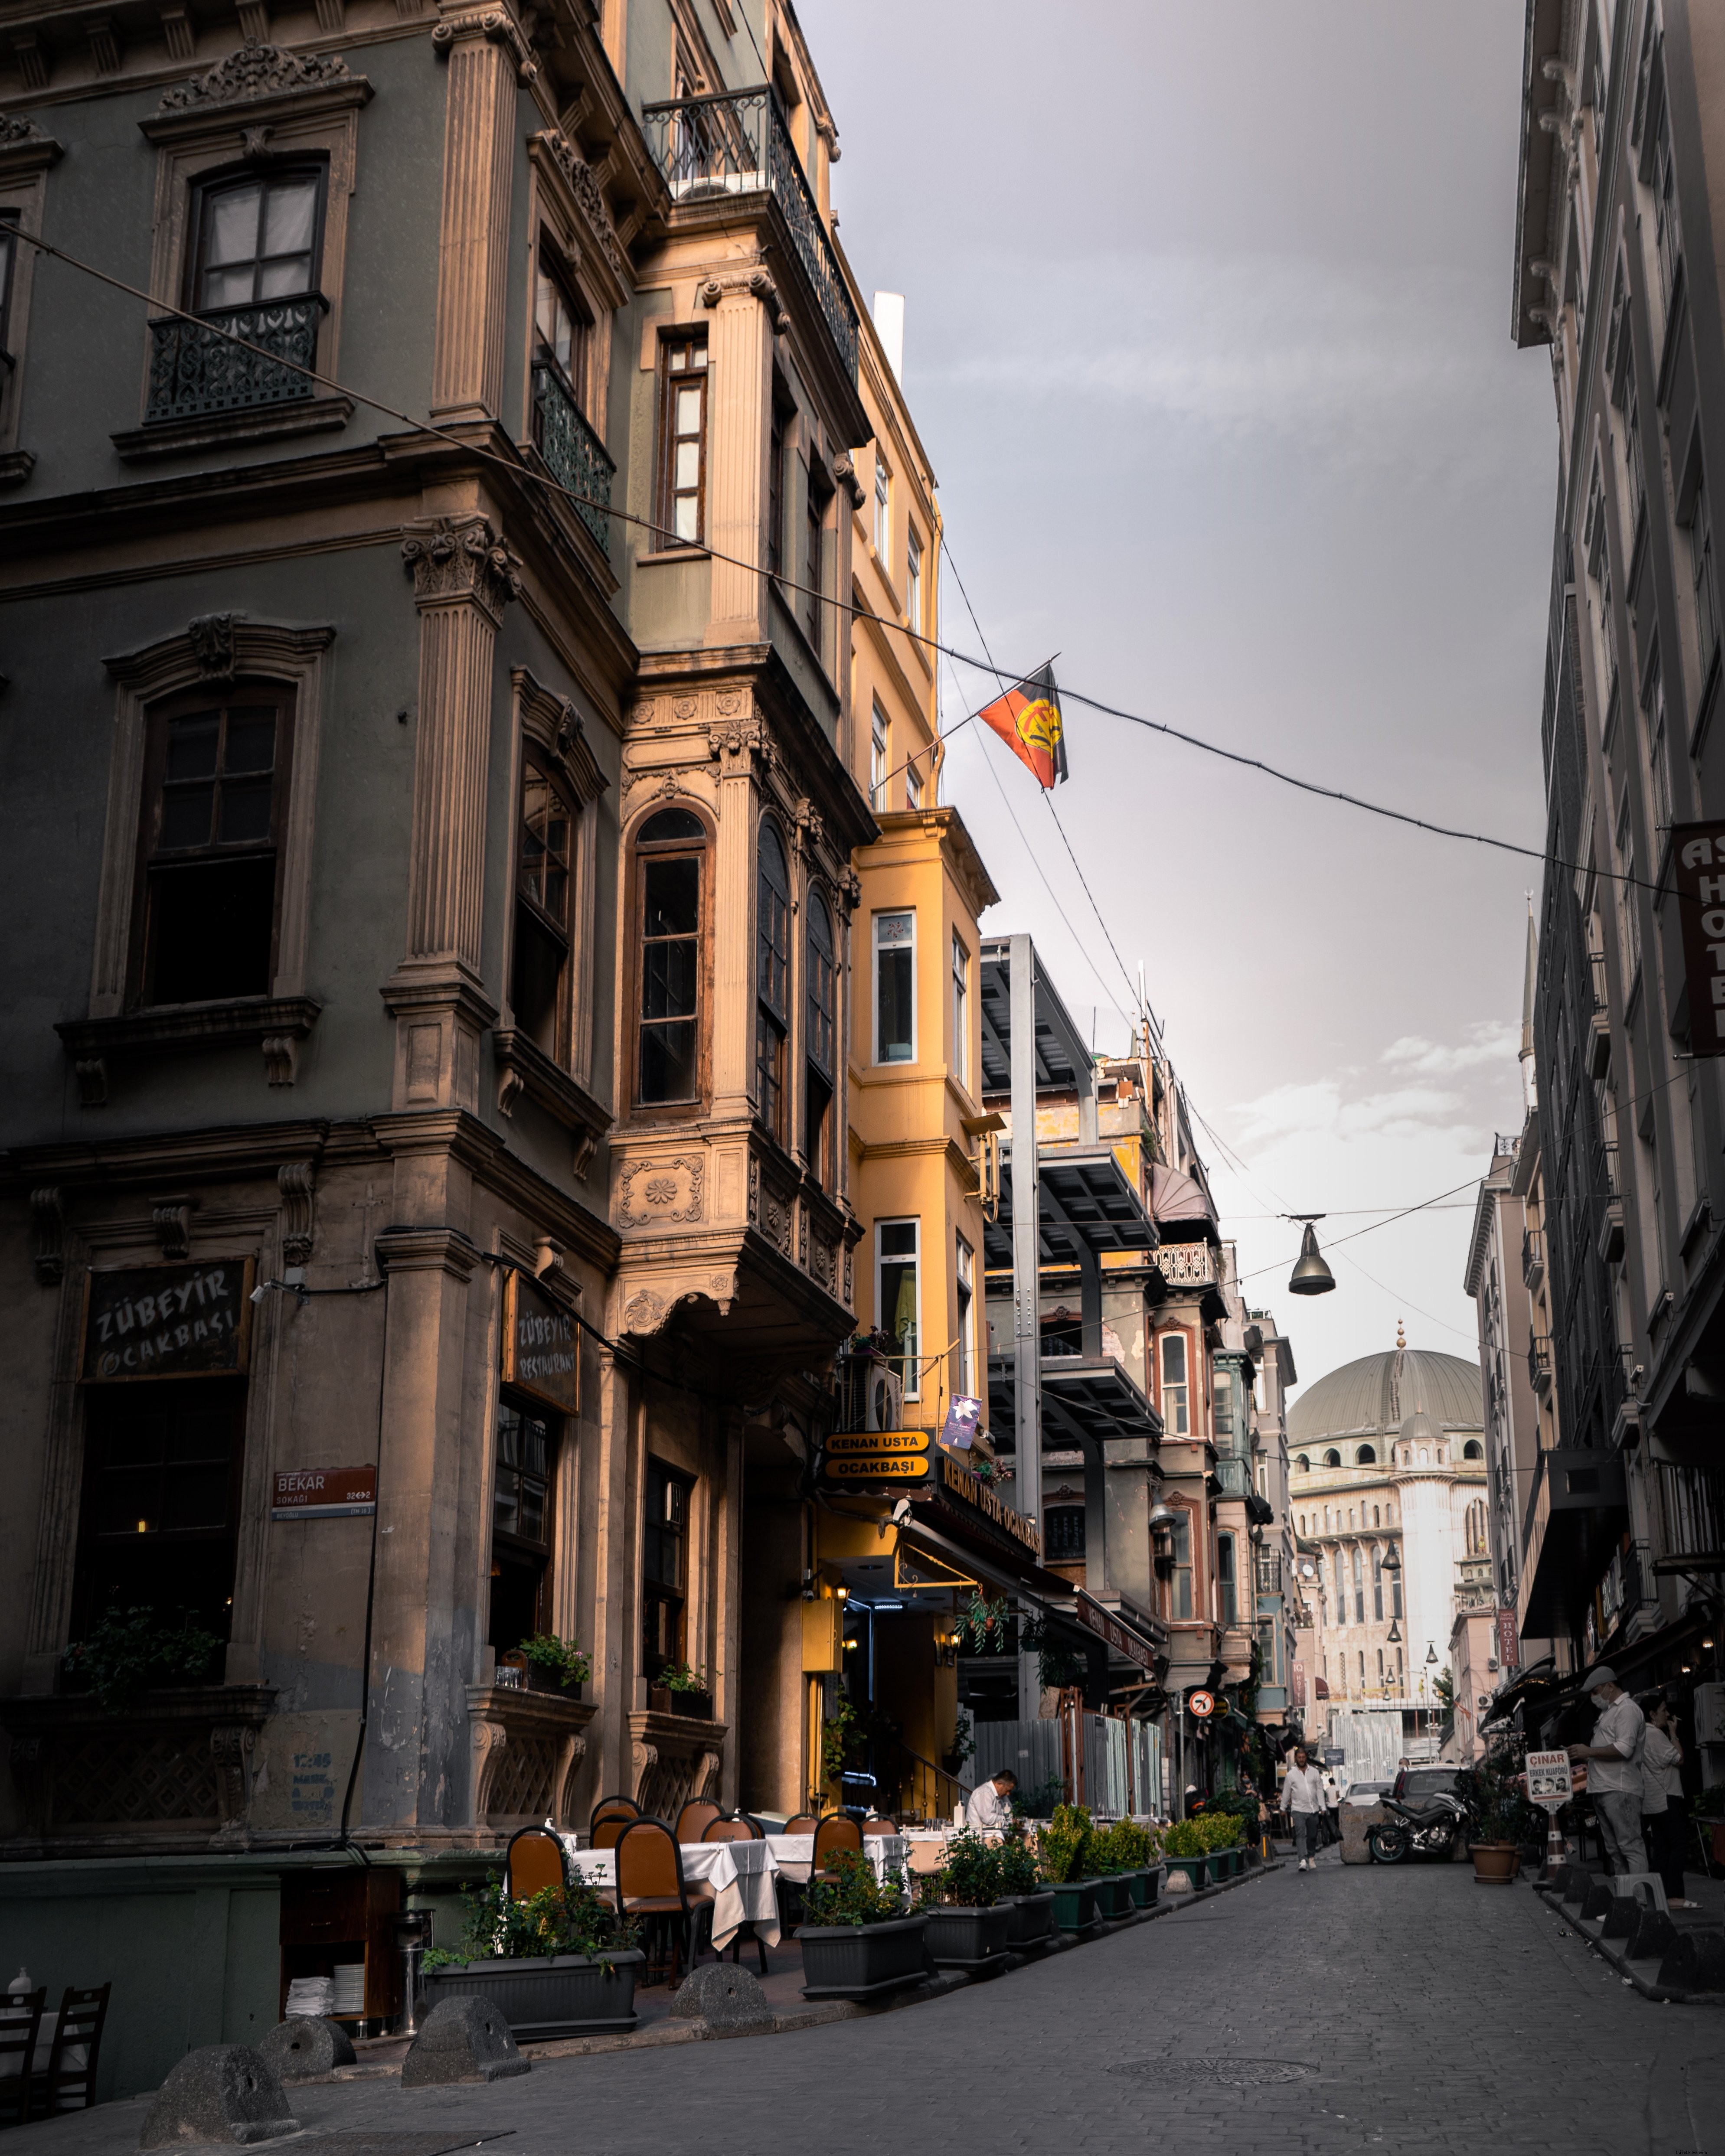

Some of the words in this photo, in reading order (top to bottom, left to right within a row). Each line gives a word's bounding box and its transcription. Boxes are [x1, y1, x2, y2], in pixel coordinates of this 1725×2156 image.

[97, 1269, 229, 1343] ZÜBEYİR
[103, 1309, 234, 1376] OCAKBAŞI
[519, 1351, 575, 1380] RESTAURANT
[831, 1438, 878, 1449] KENAN
[883, 1436, 918, 1447] USTA
[838, 1461, 914, 1474] OCAKBAŞI
[278, 1476, 325, 1492] BEKAR
[944, 1456, 977, 1507] KENAN
[980, 1483, 1003, 1526] USTA
[276, 1494, 307, 1504] SOKAĞI
[1088, 1604, 1104, 1636] KENAN
[1110, 1621, 1123, 1650] USTA
[1503, 1621, 1513, 1662] HOTEL
[1293, 1663, 1304, 1673] IQ
[1530, 1754, 1565, 1768] ÇINAR
[1529, 1768, 1545, 1777] ERKEK
